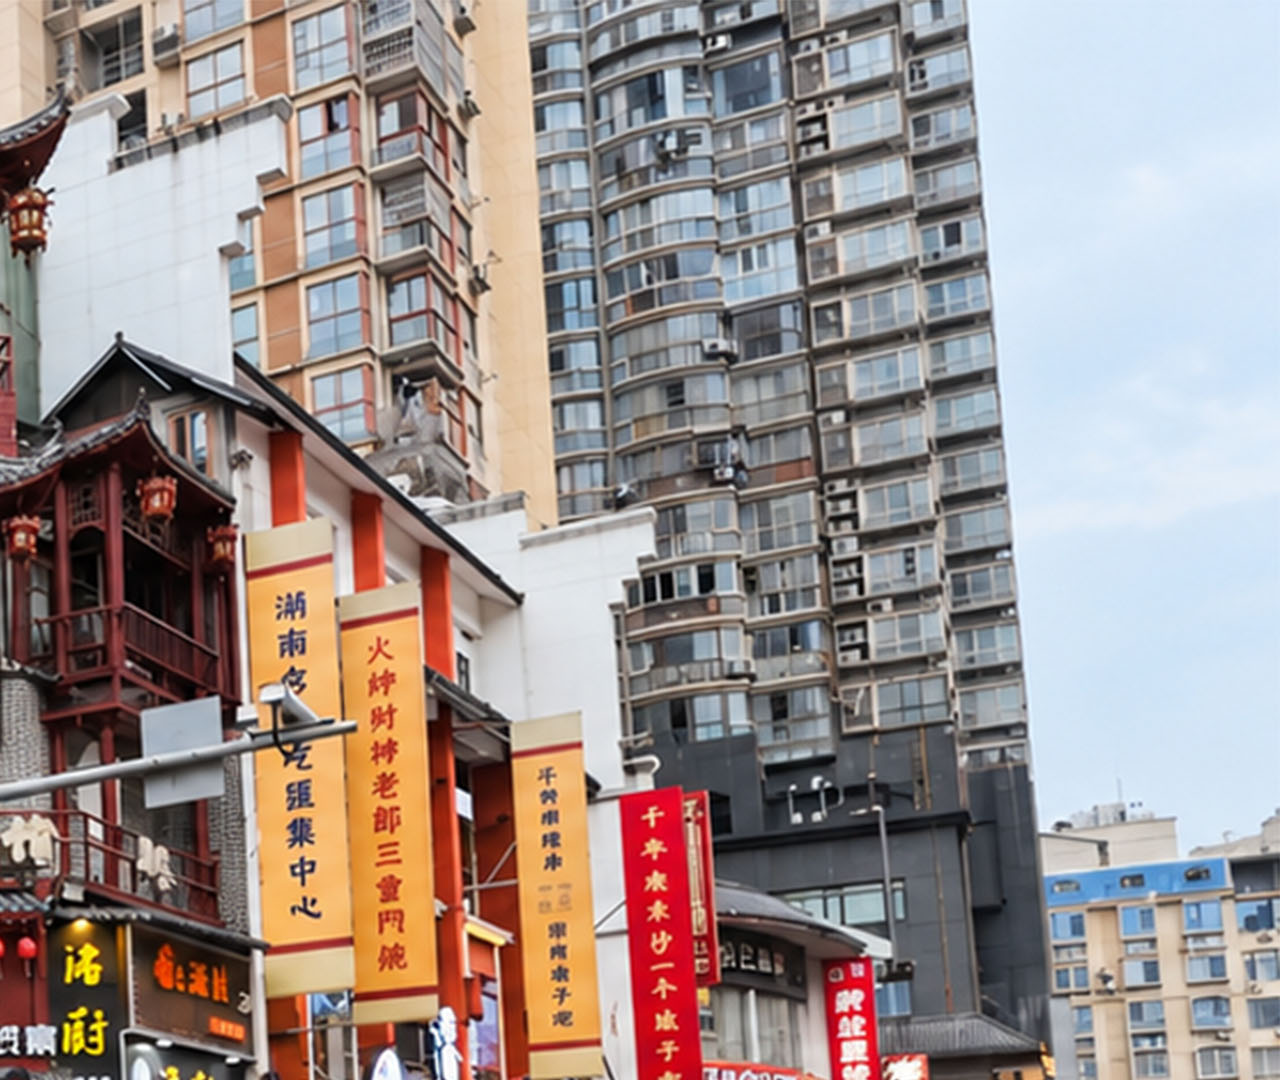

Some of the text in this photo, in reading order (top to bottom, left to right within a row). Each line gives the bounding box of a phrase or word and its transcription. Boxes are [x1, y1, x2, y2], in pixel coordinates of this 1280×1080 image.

[274, 590, 323, 920] 湖南名吃匯集中心
